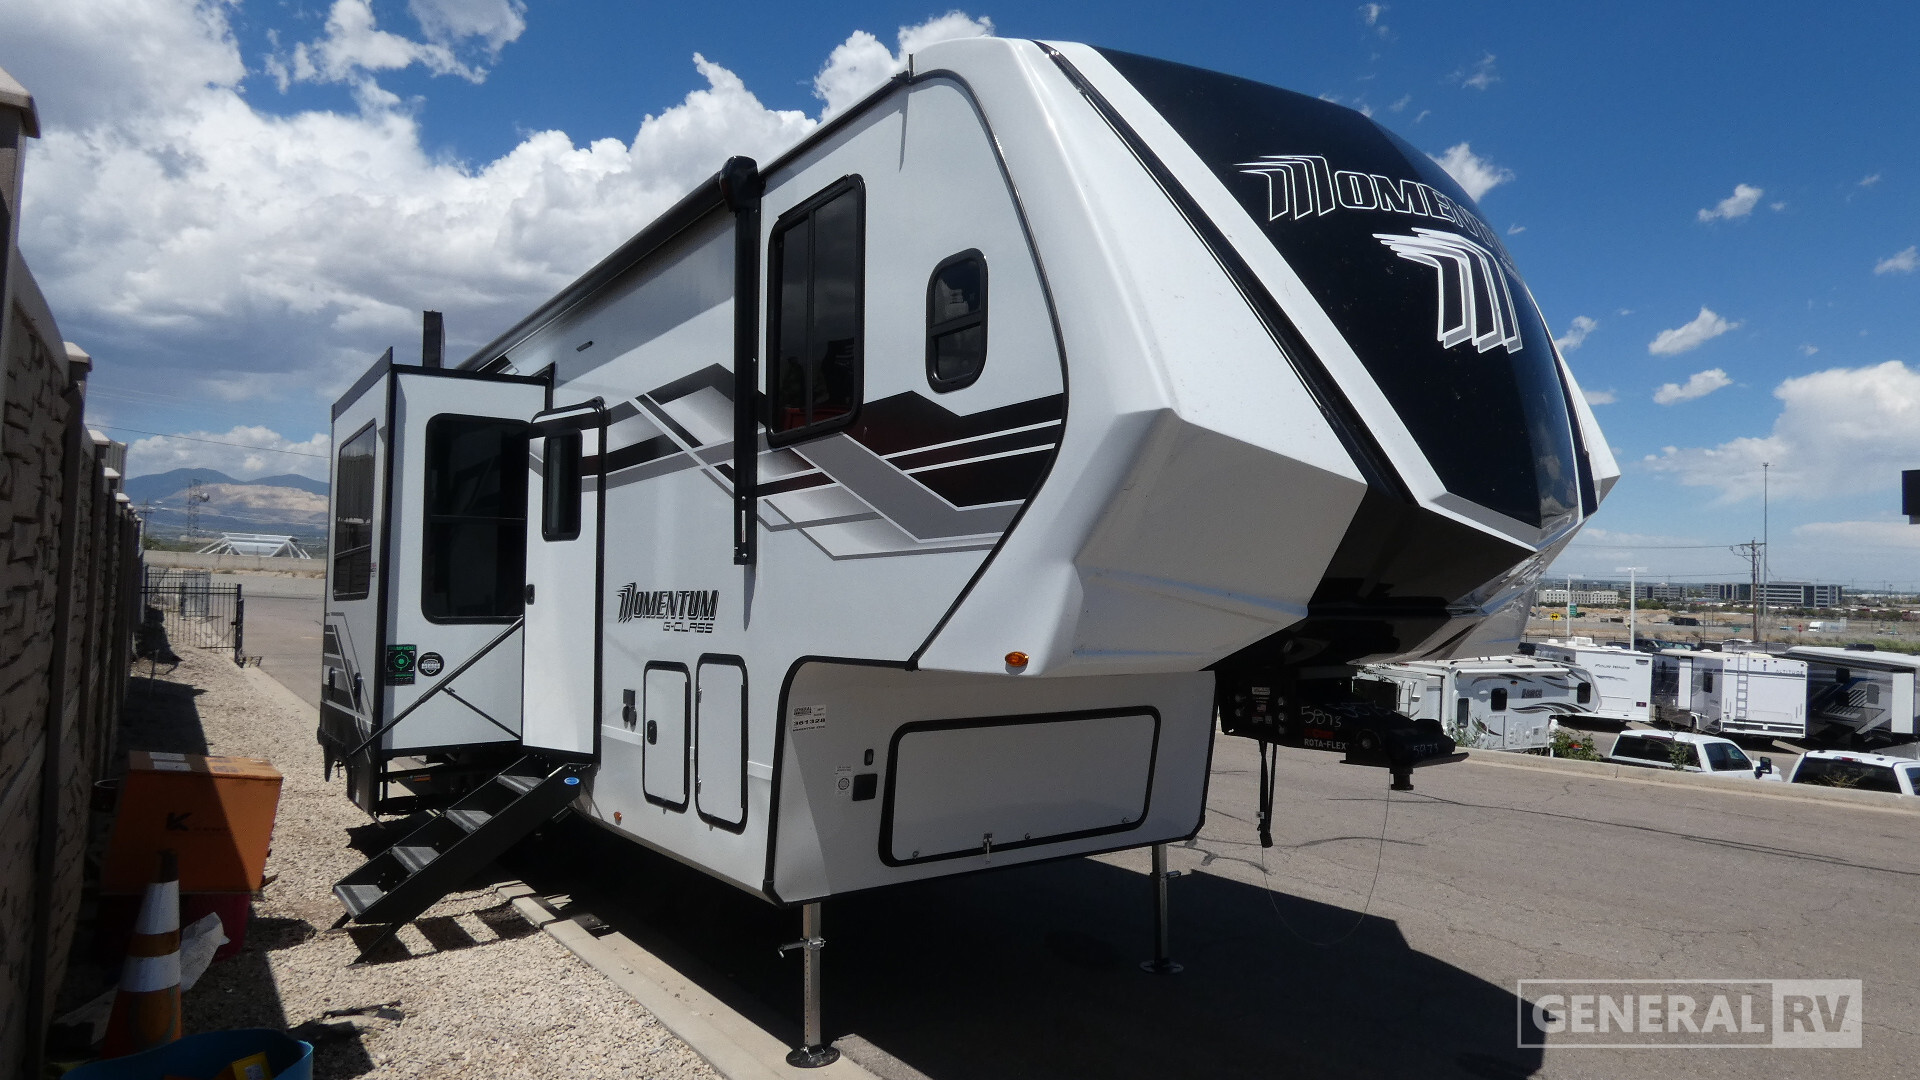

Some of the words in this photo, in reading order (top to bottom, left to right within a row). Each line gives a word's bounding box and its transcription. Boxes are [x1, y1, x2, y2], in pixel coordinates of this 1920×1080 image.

[616, 582, 719, 623] MOMENTUM
[662, 621, 713, 633] G-CLASS
[1304, 738, 1347, 750] ROTA-FLEX
